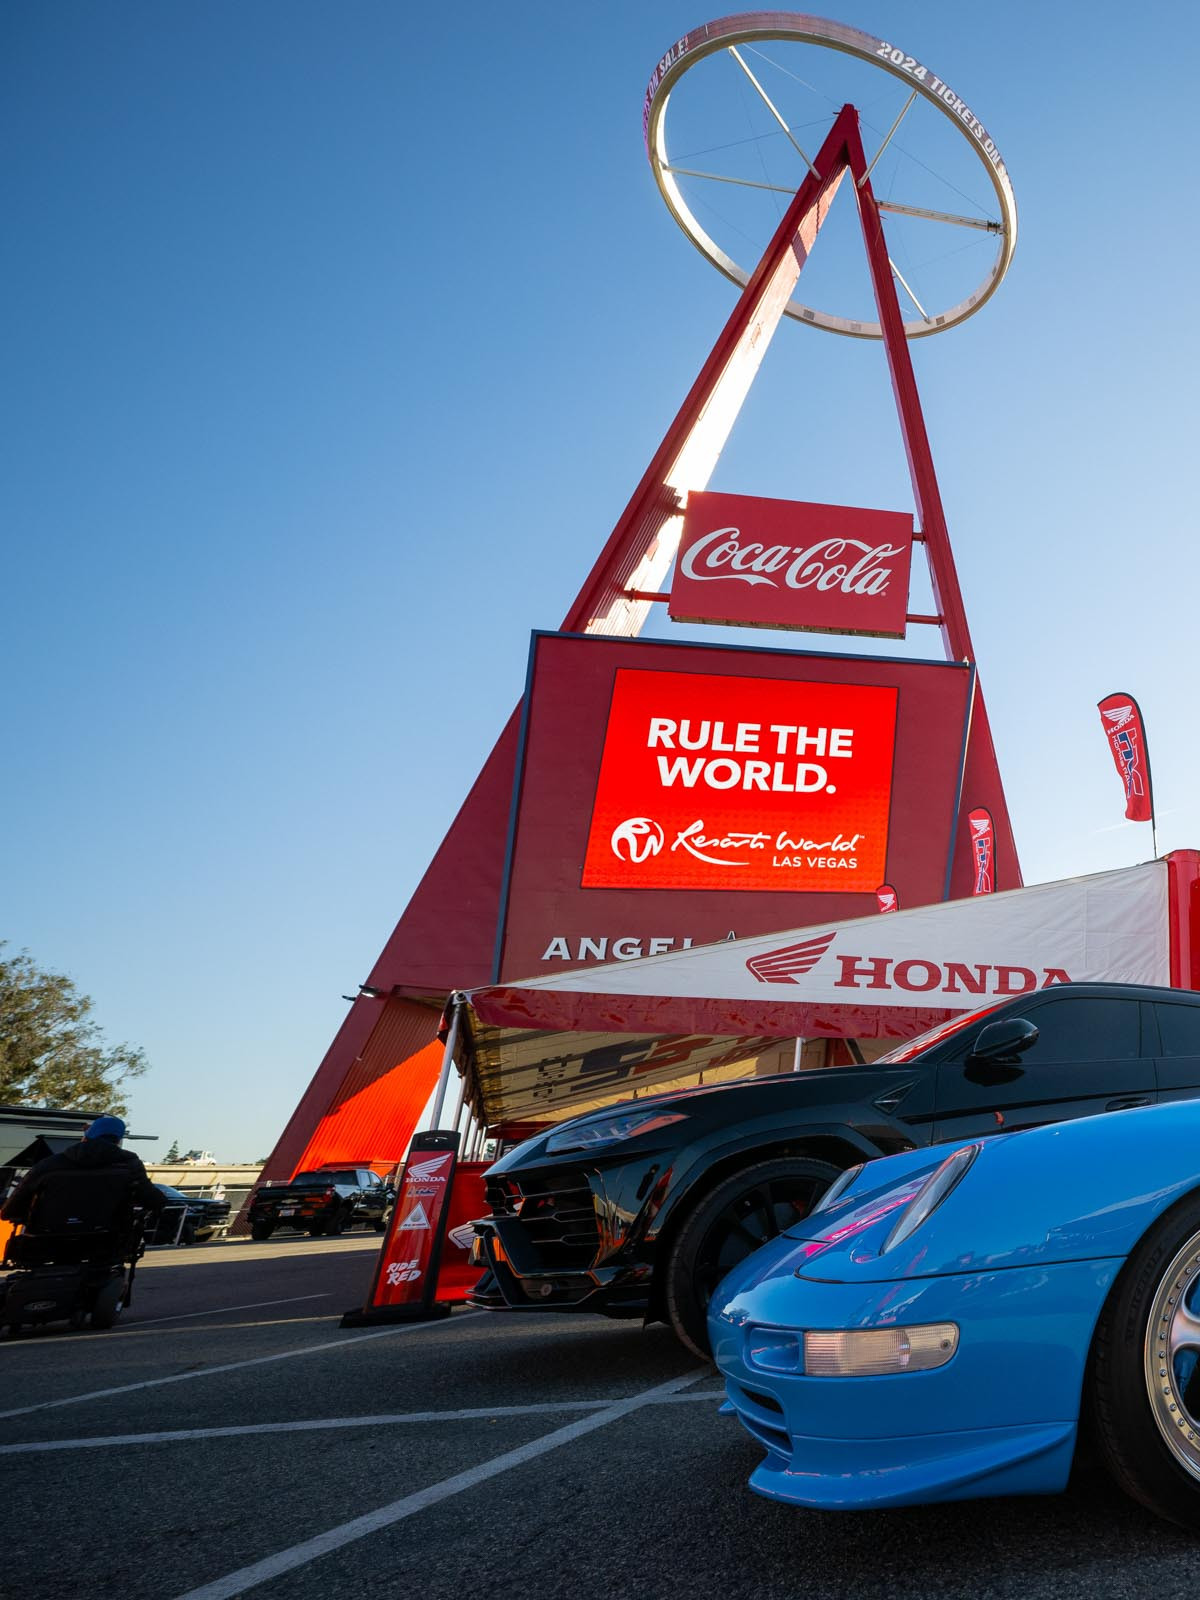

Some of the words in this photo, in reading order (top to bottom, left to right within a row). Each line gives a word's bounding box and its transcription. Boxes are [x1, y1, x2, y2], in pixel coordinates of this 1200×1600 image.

[659, 34, 690, 77] SALE!
[876, 41, 929, 81] 2024
[930, 76, 986, 139] TICKETS
[984, 138, 1001, 165] ON
[680, 527, 906, 596] Coca-Cola
[647, 717, 761, 753] RULE
[770, 724, 854, 758] THE
[656, 755, 837, 794] WORLD.
[671, 819, 771, 866] Resort
[776, 831, 859, 852] World
[772, 855, 801, 868] LAS
[808, 856, 858, 869] VEGAS
[386, 1259, 419, 1273] RIDE
[386, 1270, 422, 1286] RED
